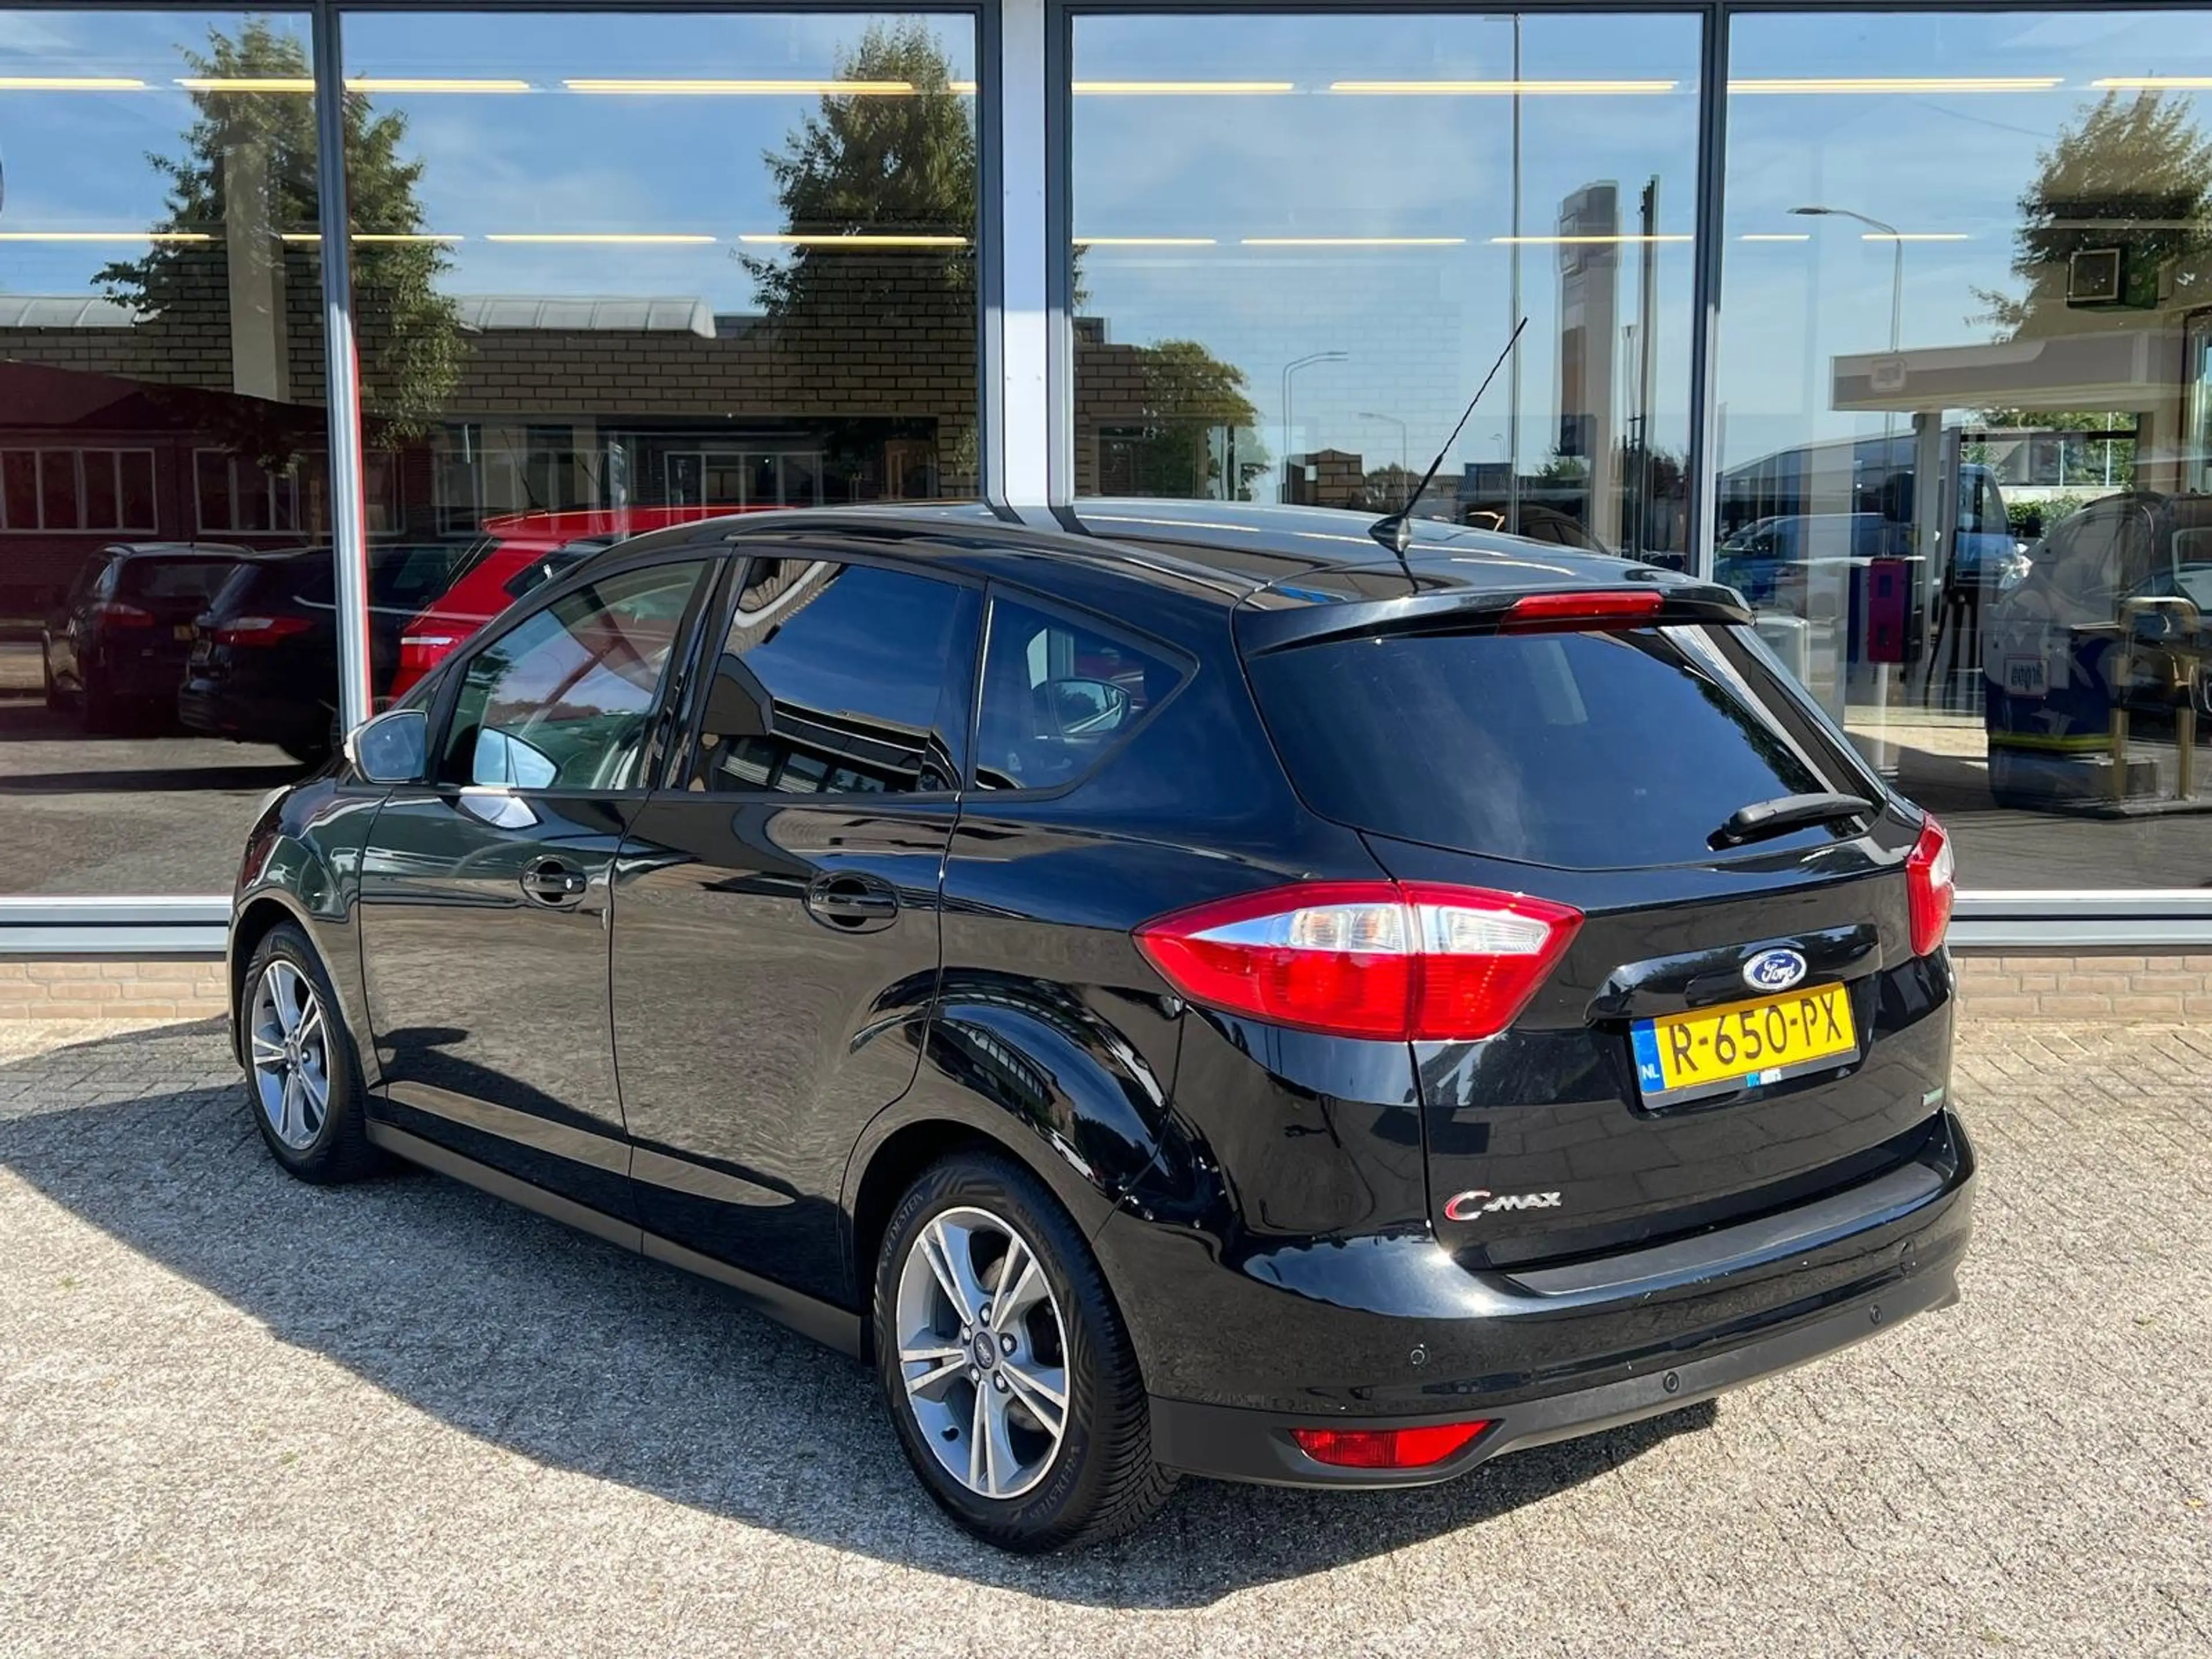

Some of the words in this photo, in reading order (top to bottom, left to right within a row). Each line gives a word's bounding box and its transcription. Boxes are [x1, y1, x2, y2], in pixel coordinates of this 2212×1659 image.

[1761, 959, 1796, 983] Ford
[1668, 991, 1843, 1075] R-650-PX
[1641, 1063, 1660, 1079] NL
